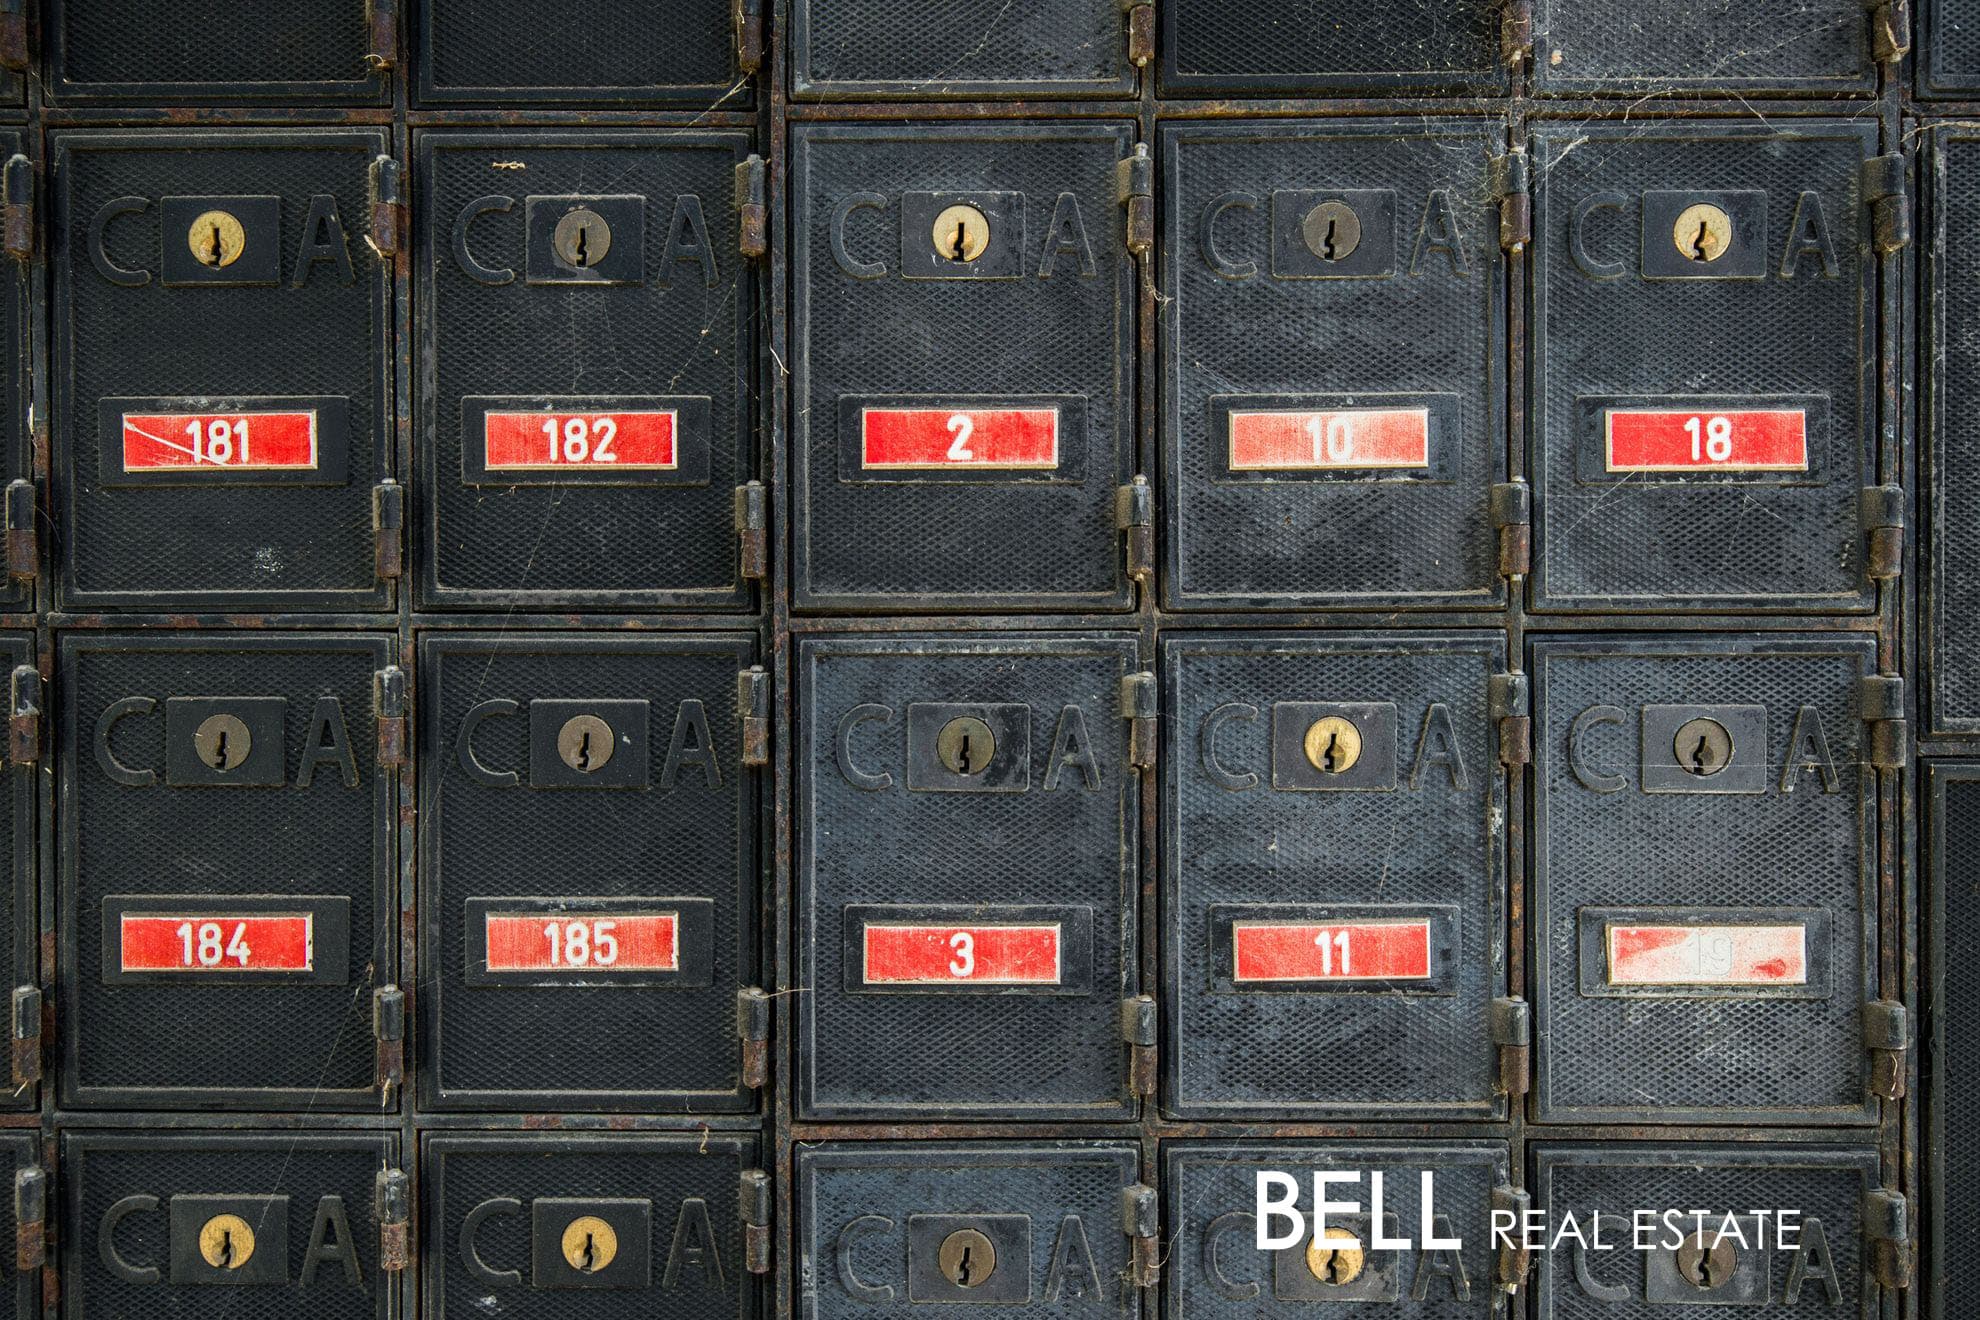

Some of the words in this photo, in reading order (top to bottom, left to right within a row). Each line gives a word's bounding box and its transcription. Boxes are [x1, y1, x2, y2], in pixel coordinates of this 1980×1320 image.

[90, 196, 152, 286] C
[293, 195, 356, 286] A
[451, 195, 516, 286] C
[658, 195, 720, 287] A
[829, 192, 888, 279] C
[1038, 192, 1096, 279] A
[1203, 192, 1258, 279] C
[1410, 190, 1470, 277] A
[1569, 191, 1628, 279] C
[1780, 191, 1839, 278] A
[187, 419, 250, 463] 181
[541, 418, 617, 463] 182
[947, 416, 974, 461] 2
[1305, 417, 1355, 462] 10
[1683, 416, 1732, 461] 18
[95, 696, 157, 786] C
[297, 696, 360, 787] A
[457, 698, 520, 786] C
[661, 698, 722, 787] A
[835, 703, 893, 790] C
[1043, 704, 1101, 791] A
[1204, 702, 1259, 790] C
[1410, 702, 1470, 791] A
[1569, 704, 1628, 794] C
[1780, 704, 1840, 794] A
[176, 922, 251, 966] 184
[543, 922, 619, 966] 185
[949, 932, 975, 977] 3
[1313, 930, 1350, 975] 11
[1686, 932, 1733, 977] 19
[100, 1195, 160, 1284] C
[303, 1195, 363, 1292] A
[461, 1198, 522, 1285] C
[662, 1198, 725, 1287] A
[837, 1215, 895, 1300] C
[1045, 1215, 1102, 1301] A
[1204, 1212, 1260, 1300] C
[1412, 1213, 1471, 1301] A
[1573, 1214, 1632, 1301] C
[1784, 1217, 1843, 1305] A
